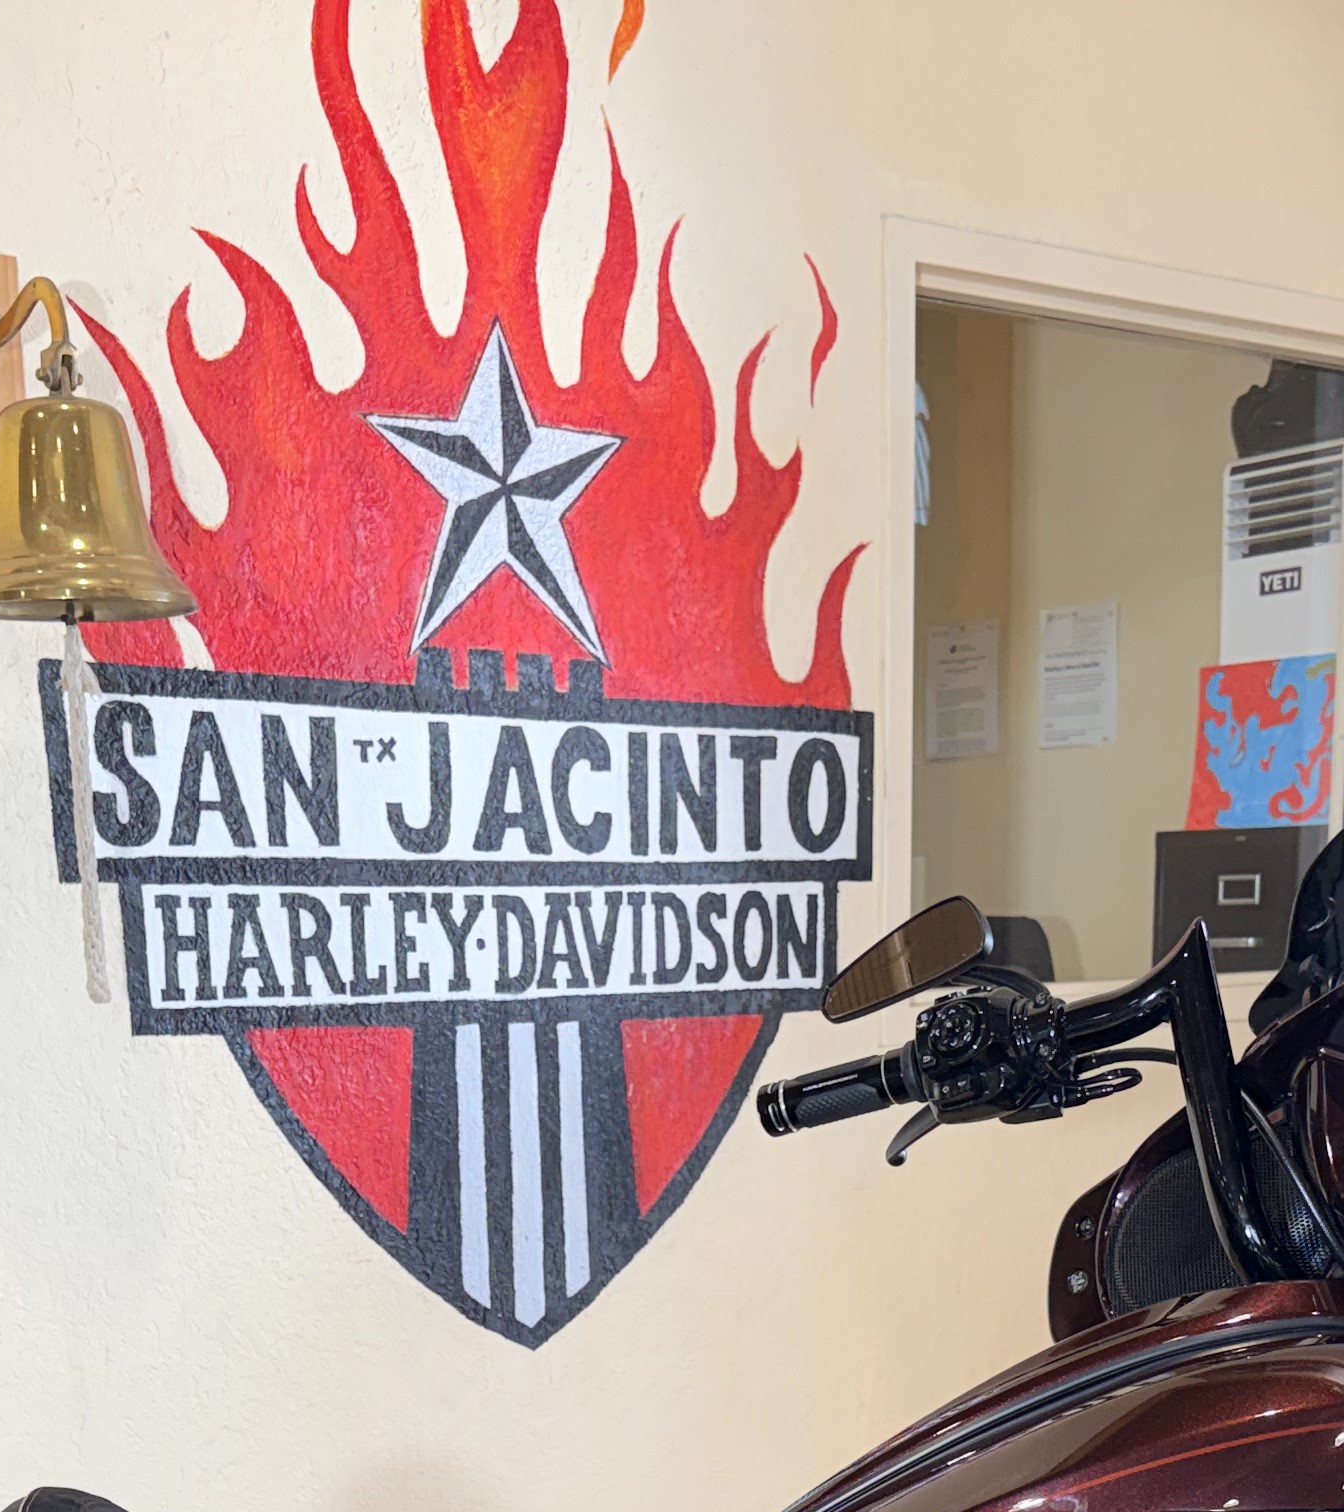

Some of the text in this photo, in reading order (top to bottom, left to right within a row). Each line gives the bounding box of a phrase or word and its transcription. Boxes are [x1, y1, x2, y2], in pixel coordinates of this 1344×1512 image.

[1261, 571, 1300, 593] YETI
[92, 700, 847, 856] SAN TX JACINTO
